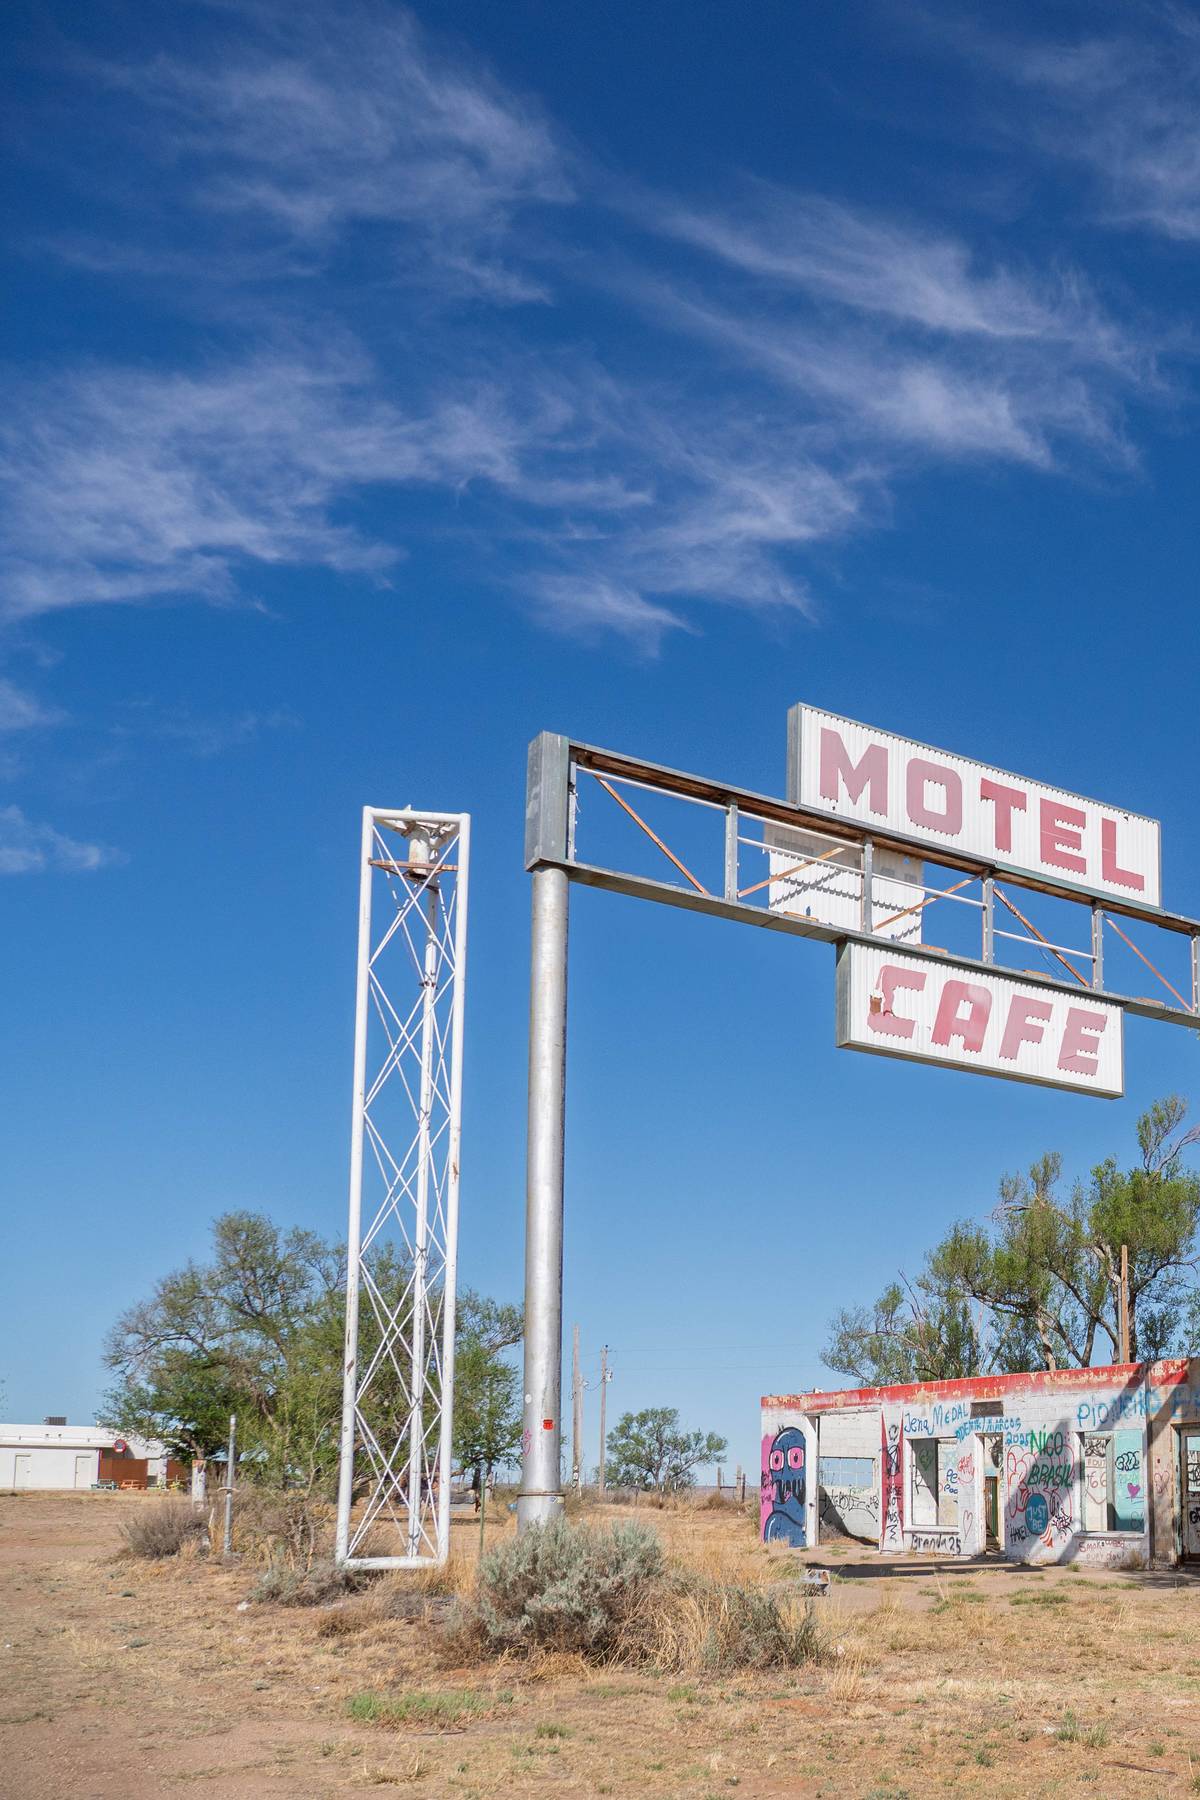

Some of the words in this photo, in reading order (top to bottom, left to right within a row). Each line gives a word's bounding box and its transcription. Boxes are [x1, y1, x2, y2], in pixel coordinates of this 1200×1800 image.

[819, 727, 1145, 892] MOTEL
[866, 964, 1109, 1076] CAFE
[1027, 1463, 1073, 1488] BRASIL
